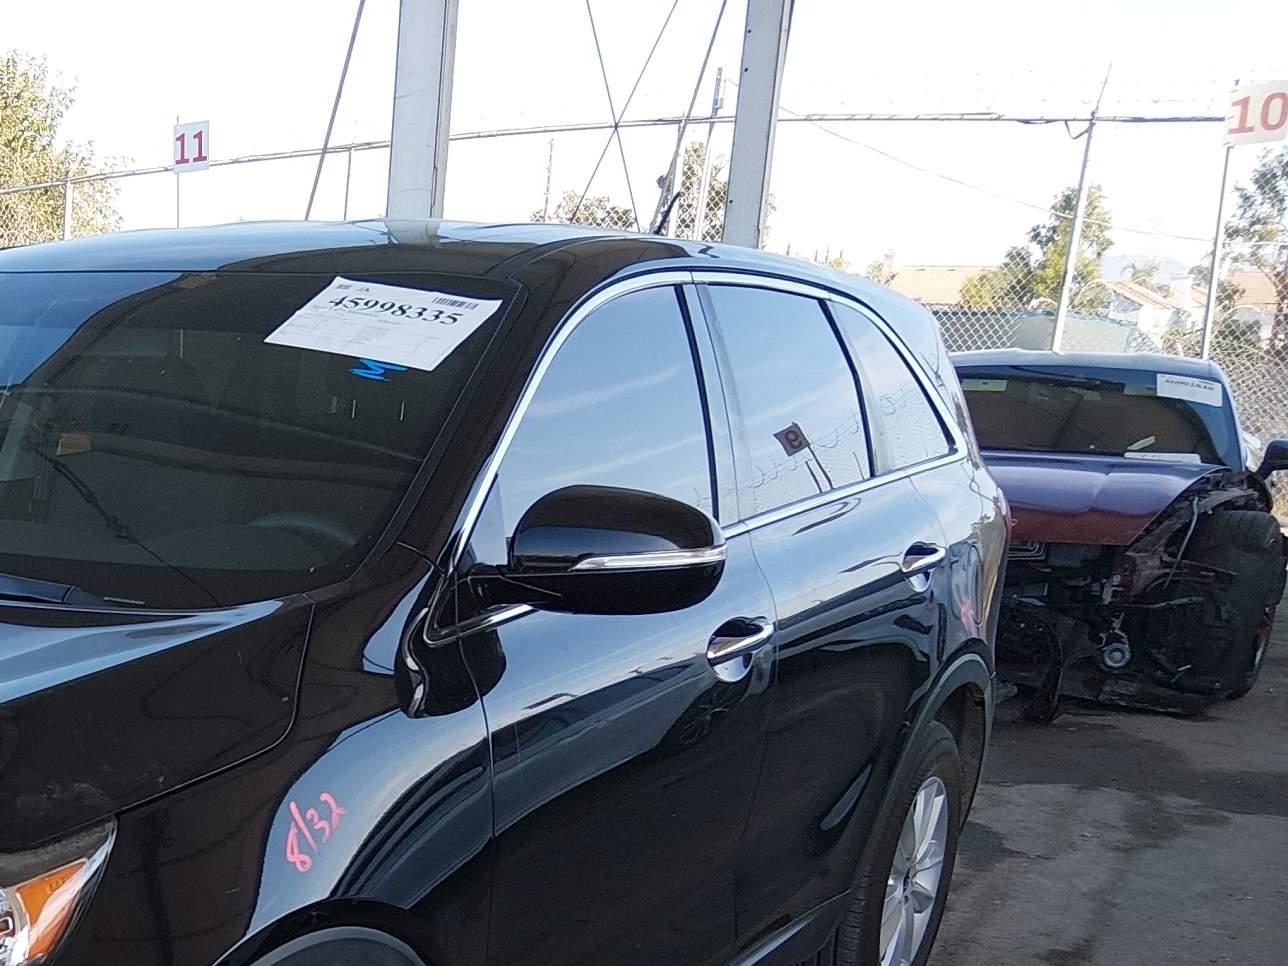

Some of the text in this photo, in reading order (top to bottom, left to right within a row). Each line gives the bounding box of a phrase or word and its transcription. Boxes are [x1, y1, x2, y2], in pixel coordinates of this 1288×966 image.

[1227, 92, 1288, 134] 10
[175, 130, 208, 165] 11
[328, 295, 464, 325] 45998335
